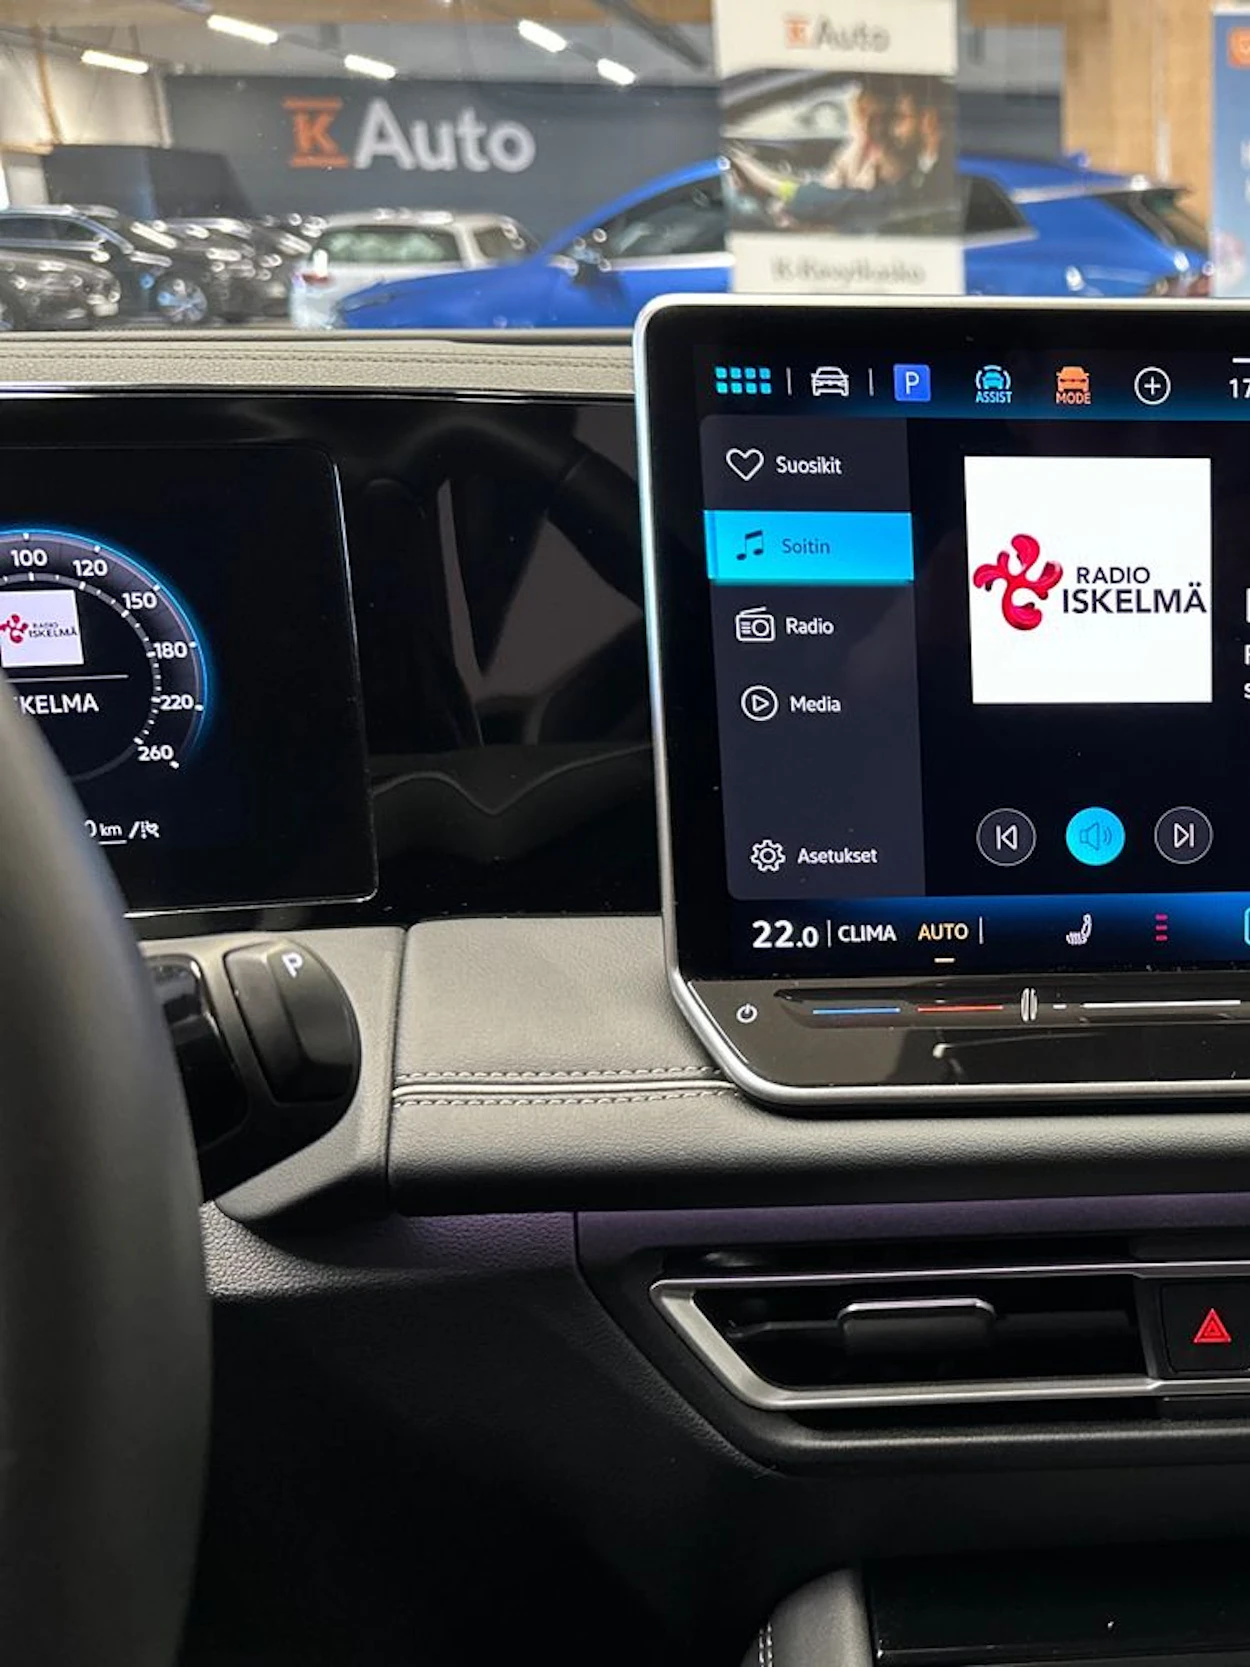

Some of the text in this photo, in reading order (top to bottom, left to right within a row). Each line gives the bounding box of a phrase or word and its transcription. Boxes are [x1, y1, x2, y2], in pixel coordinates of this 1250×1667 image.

[283, 96, 536, 173] K Auto
[975, 390, 1013, 404] ASSIST
[1056, 391, 1091, 405] MODE
[775, 455, 843, 477] Suosikit
[781, 537, 831, 556] Soitin
[11, 550, 47, 567] 100
[73, 559, 108, 577] 120
[1076, 567, 1151, 585] RADIO
[122, 593, 157, 610] 150
[1062, 582, 1208, 615] ISKELMÄ
[785, 617, 835, 637] Radio
[154, 642, 187, 659] 180
[13, 693, 100, 715] KELMA
[159, 694, 195, 712] 220
[790, 694, 842, 714] Media
[138, 744, 174, 761] 260
[100, 823, 123, 837] km
[797, 846, 878, 865] Asetukset
[751, 919, 970, 949] 22.0 CLIMA AUTO
[282, 951, 304, 978] P
